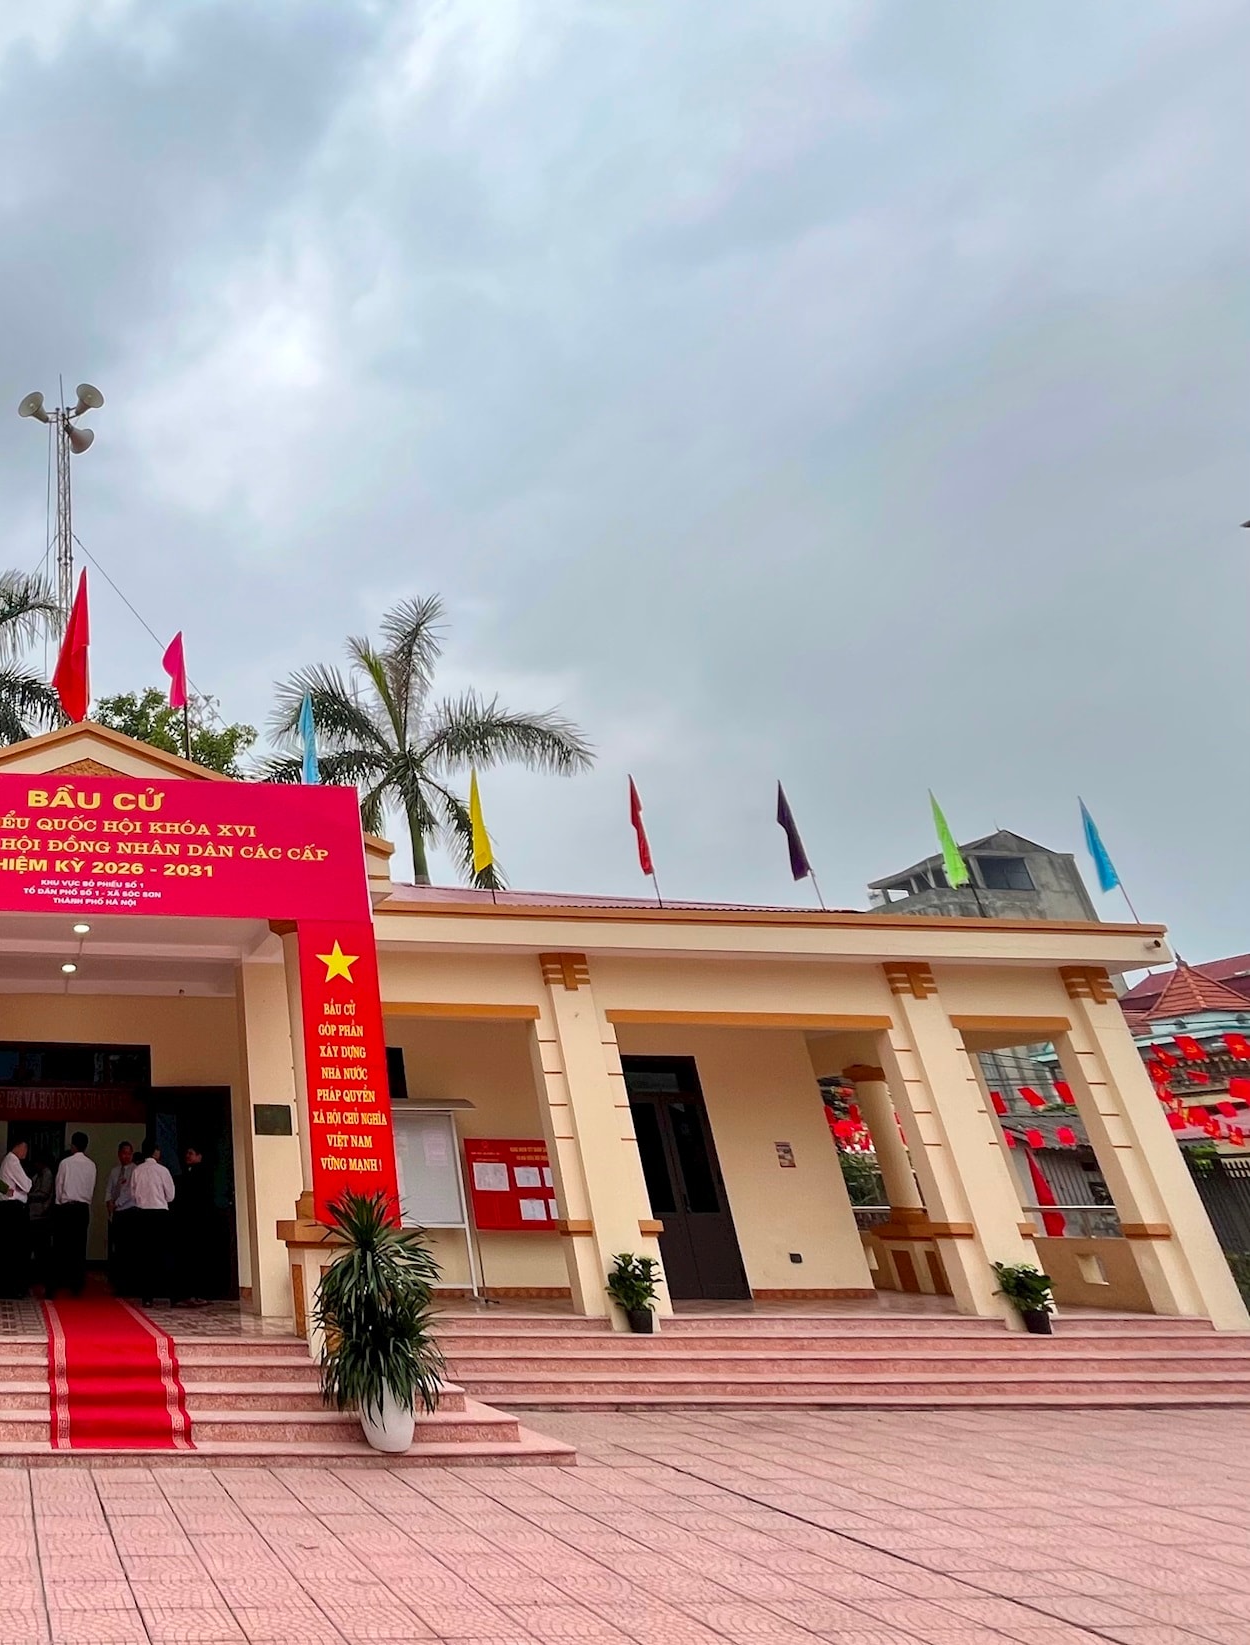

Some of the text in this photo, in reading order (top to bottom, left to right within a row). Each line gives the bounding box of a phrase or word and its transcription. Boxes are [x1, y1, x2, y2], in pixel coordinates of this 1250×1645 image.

[27, 785, 165, 811] BẦU CỬ
[36, 815, 97, 831] QUỐC
[102, 818, 142, 835] HỘI
[148, 820, 211, 836] KHÓA
[217, 824, 256, 837] XVI
[0, 835, 41, 853] HỘI
[47, 835, 111, 853] ĐỒNG
[116, 839, 181, 856] NHÂN
[187, 842, 233, 857] DÂN
[239, 844, 282, 859] CÁC
[286, 844, 329, 861] CẤP
[55, 857, 86, 873] KỲ
[91, 861, 144, 875] 2026
[163, 863, 214, 877] 2031
[326, 1131, 373, 1150] VIỆT NAM
